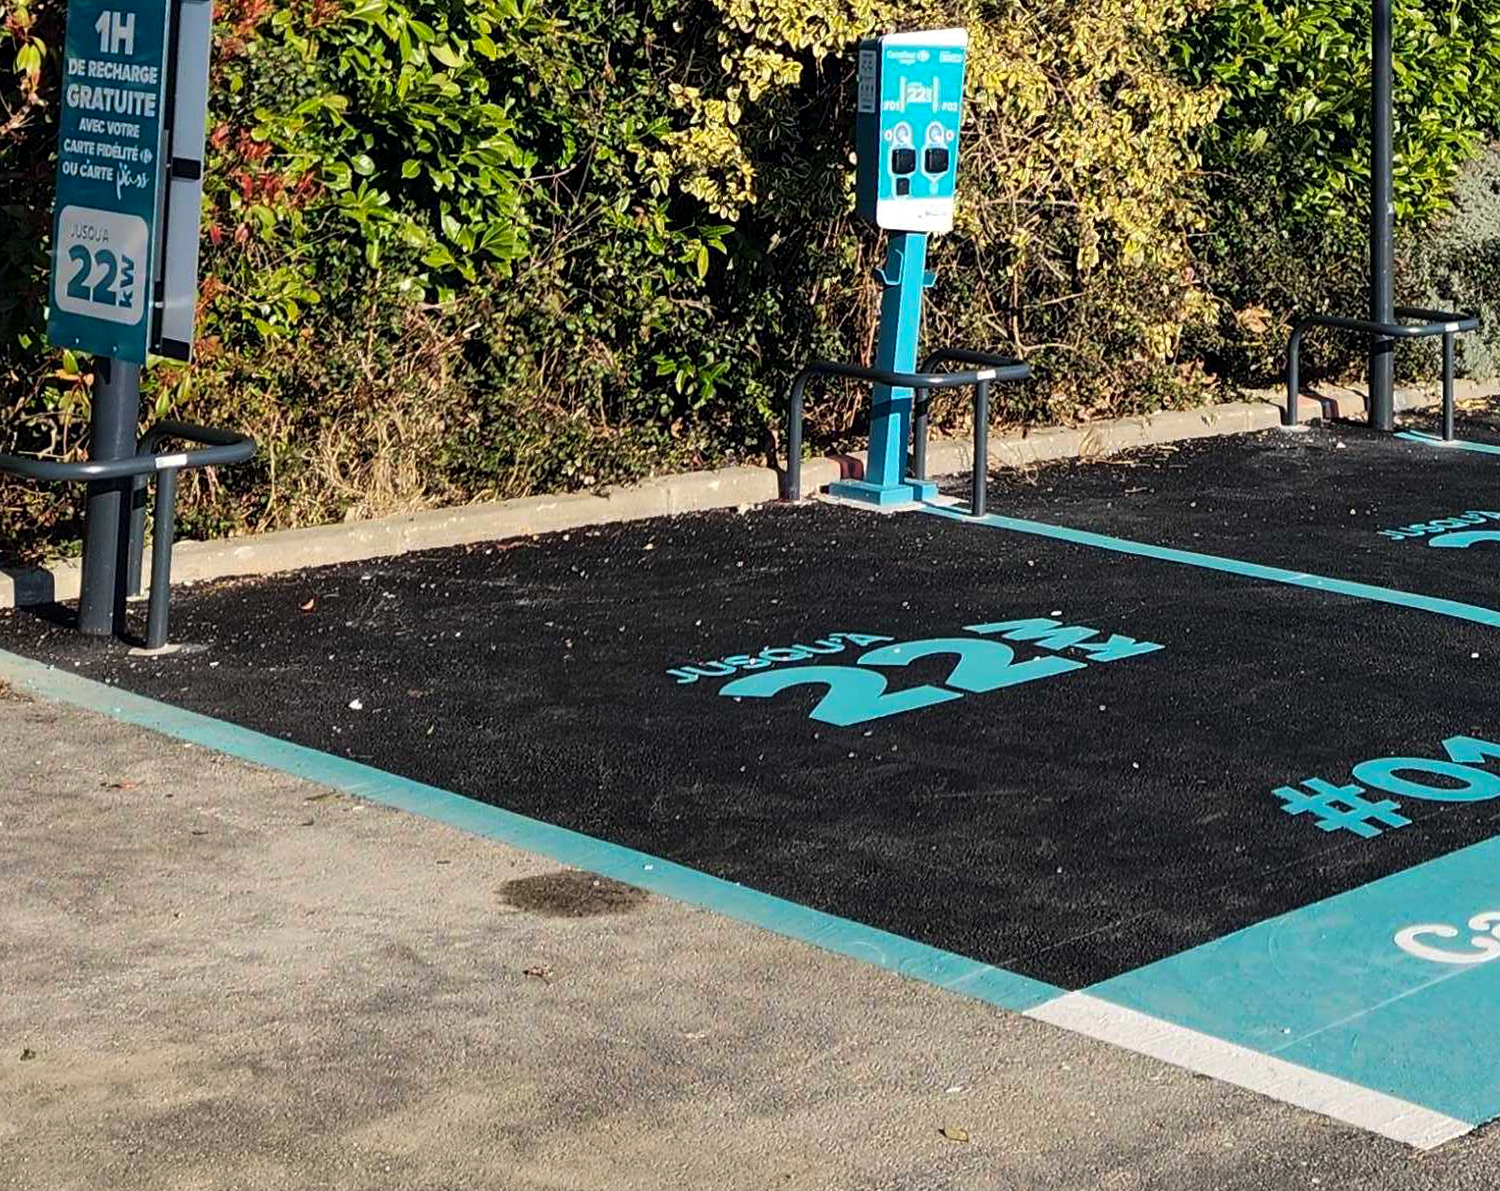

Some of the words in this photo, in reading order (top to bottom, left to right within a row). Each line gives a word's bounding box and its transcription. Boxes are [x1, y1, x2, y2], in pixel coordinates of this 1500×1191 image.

[95, 10, 136, 55] 1H
[68, 59, 86, 76] DE
[88, 60, 159, 85] RECHARGE
[66, 83, 157, 118] GRATUITE
[79, 117, 106, 134] AVEC
[107, 122, 141, 139] VOTRE
[63, 138, 95, 155] CARTE
[96, 141, 139, 162] FIDÉLITÉ
[62, 161, 78, 176] OU
[79, 164, 114, 181] CARTE
[67, 244, 117, 306] 22
[119, 255, 135, 309] kW
[718, 637, 1089, 727] 22
